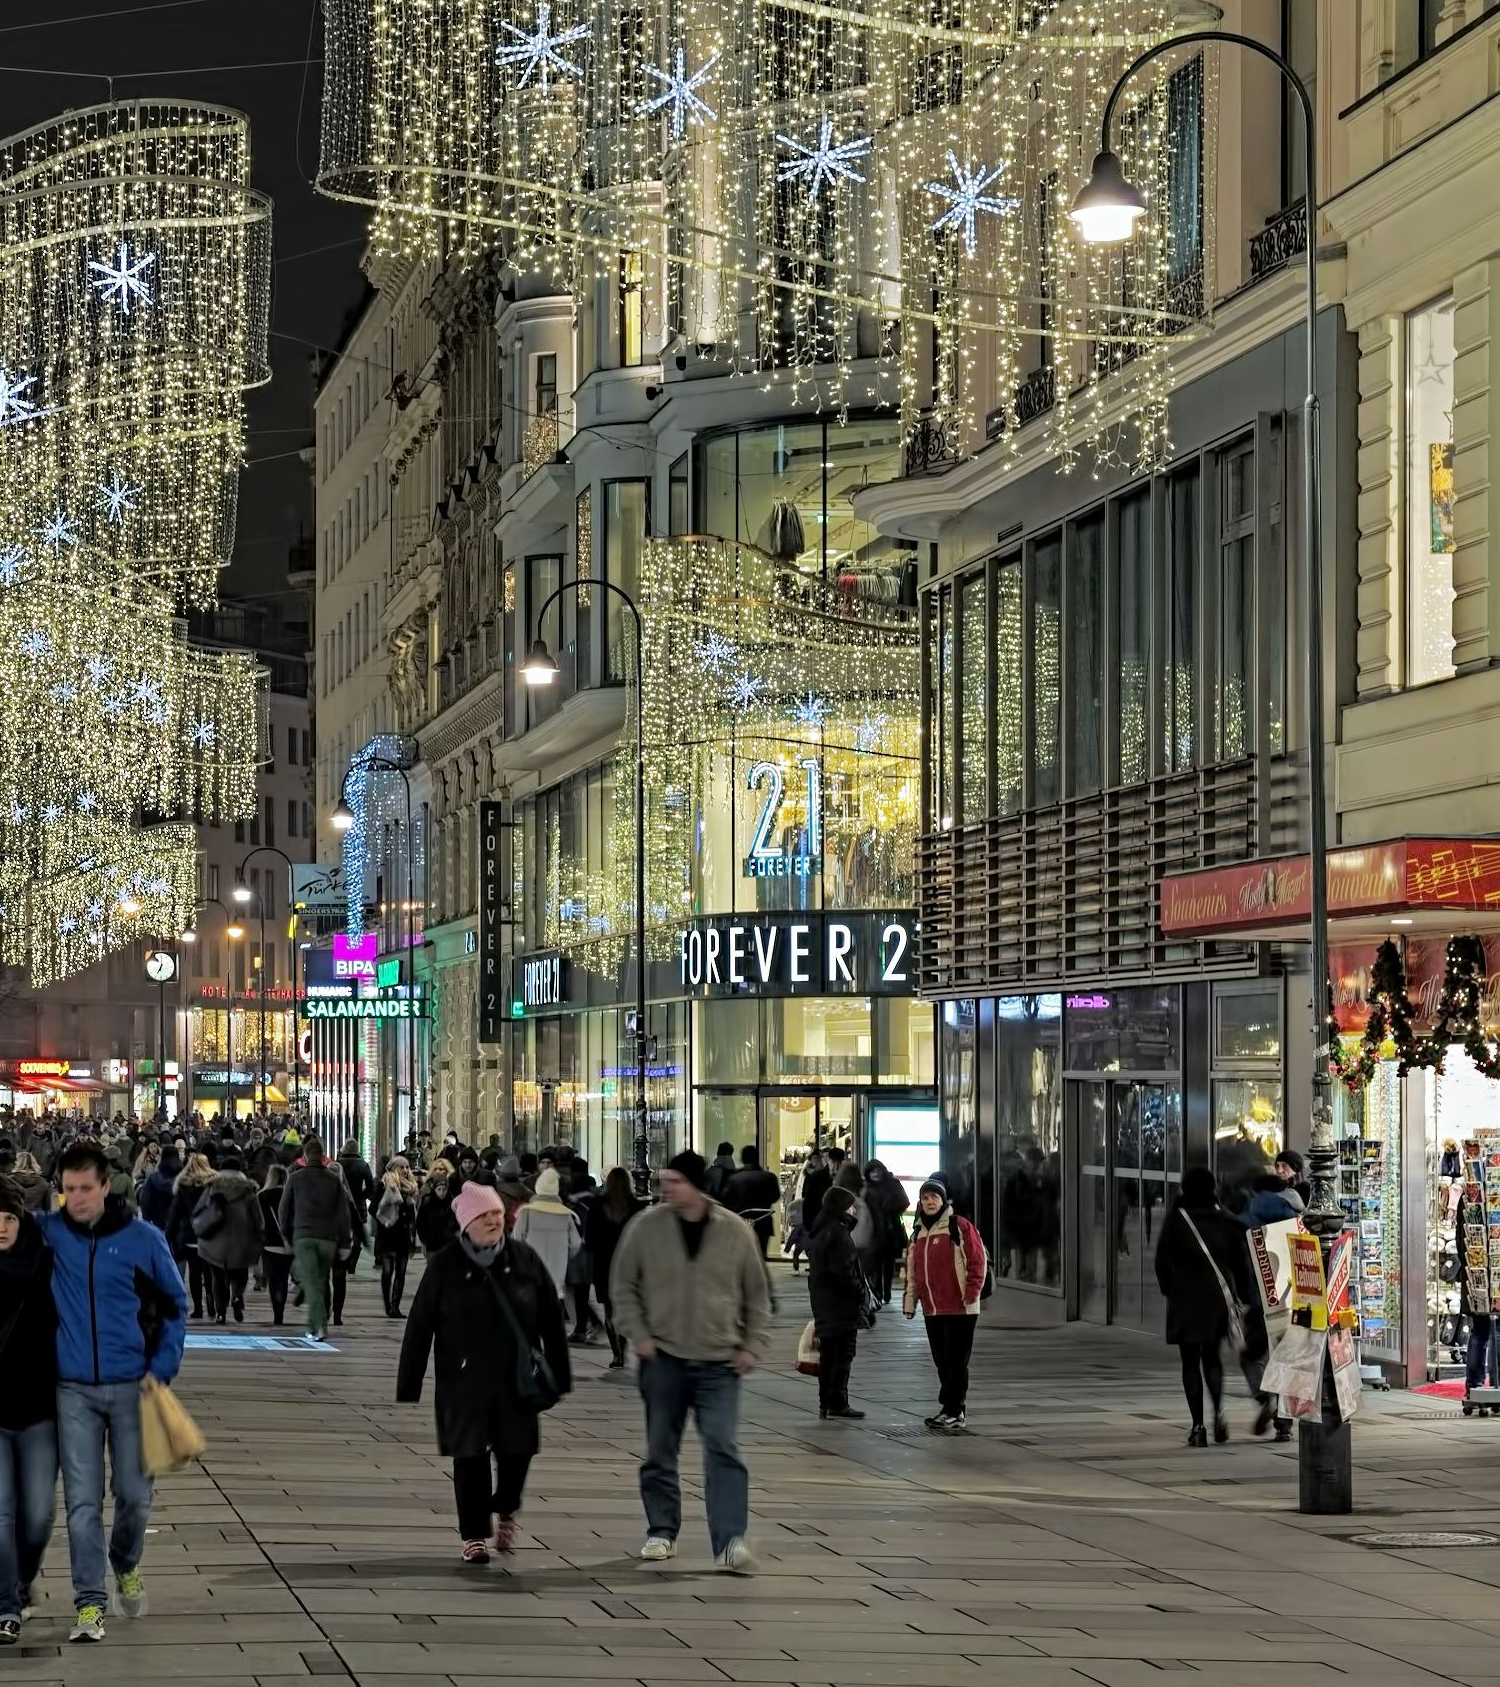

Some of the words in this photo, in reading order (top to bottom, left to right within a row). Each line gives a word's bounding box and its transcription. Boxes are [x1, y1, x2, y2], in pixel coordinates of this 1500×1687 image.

[486, 810, 496, 975] FOREVER
[1164, 884, 1228, 925] Souvenirs
[336, 960, 376, 975] BIPA
[681, 924, 854, 985] FOREVER
[882, 923, 920, 982] 2
[202, 986, 227, 998] HOTE
[306, 1000, 421, 1017] SALAMANDER
[486, 993, 496, 1036] 21
